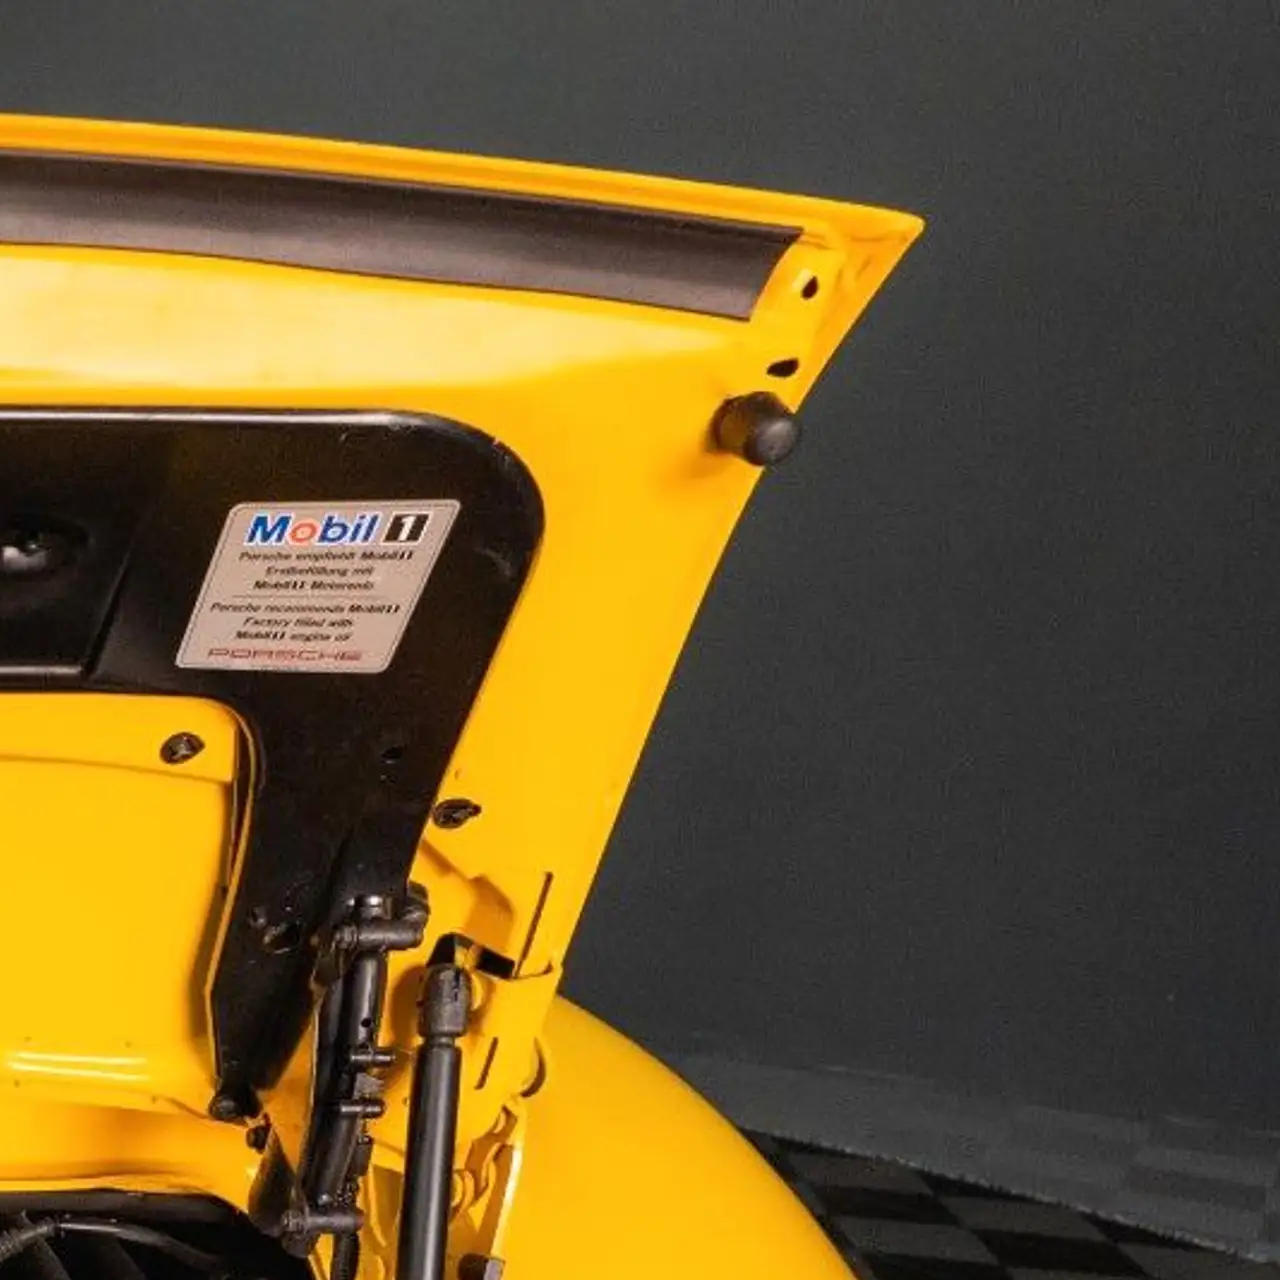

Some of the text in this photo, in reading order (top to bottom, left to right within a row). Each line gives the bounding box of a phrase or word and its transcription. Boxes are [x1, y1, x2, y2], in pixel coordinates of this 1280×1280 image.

[246, 513, 380, 545] Mobil
[239, 551, 292, 562] Porsche
[210, 602, 260, 613] Porsche
[208, 648, 362, 662] PORSCHE
